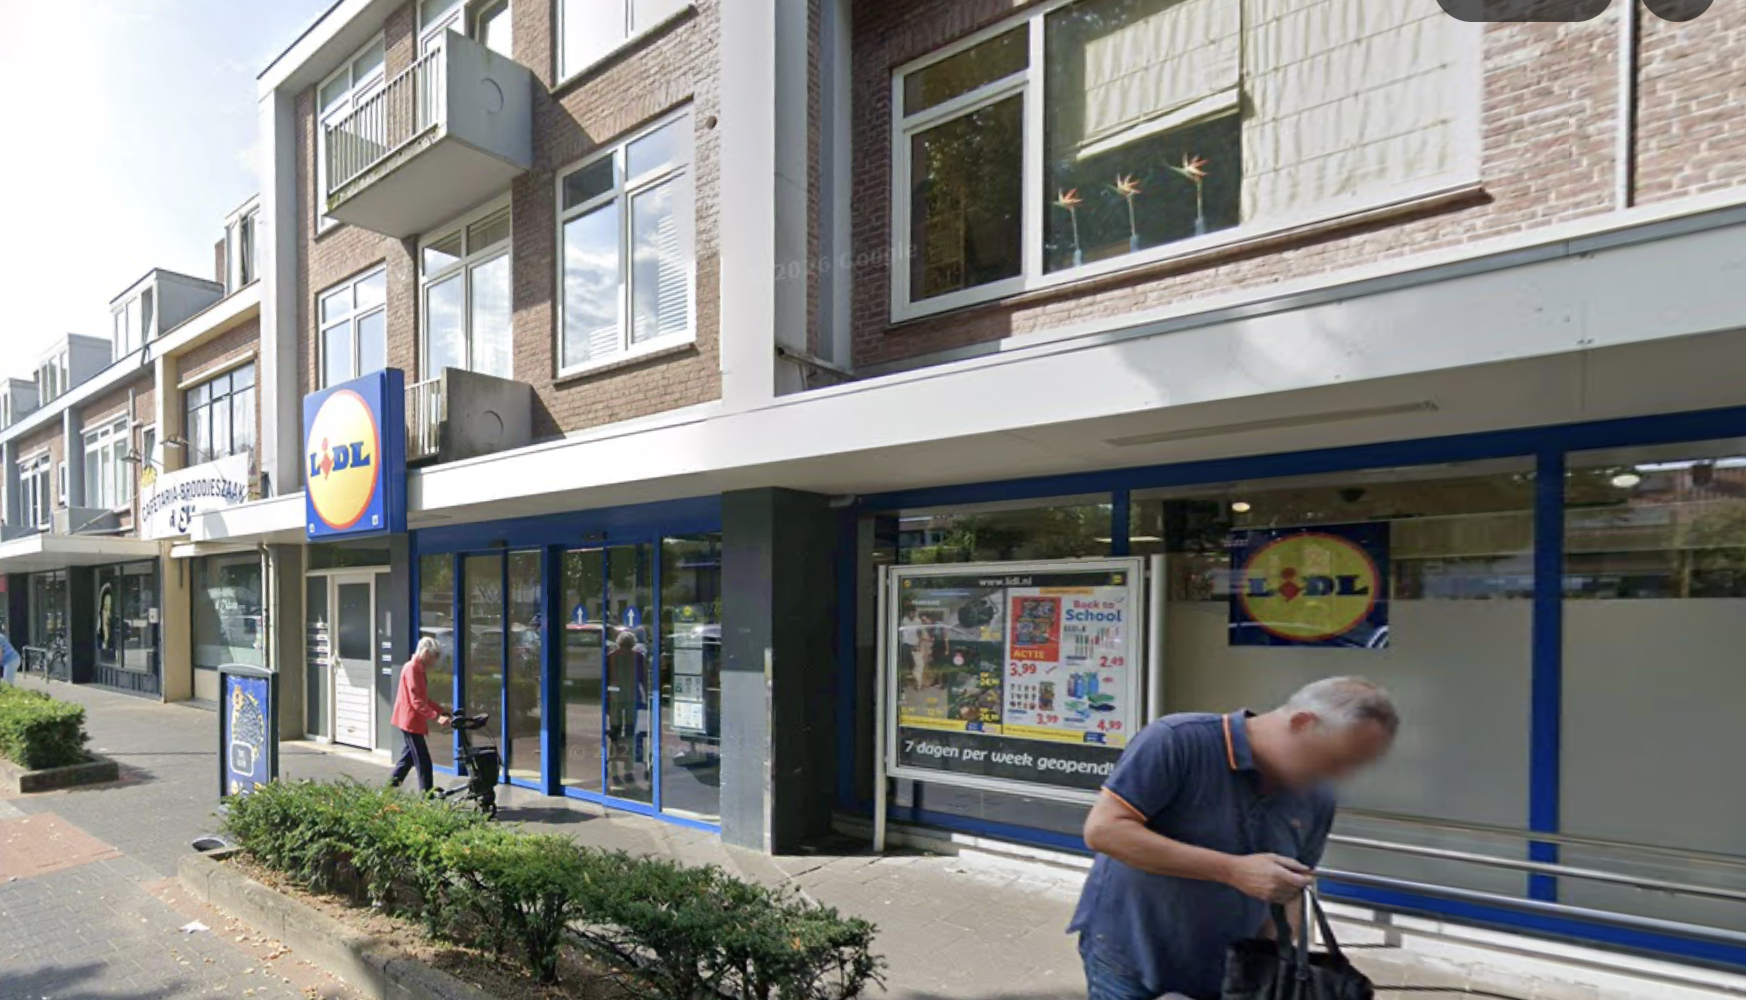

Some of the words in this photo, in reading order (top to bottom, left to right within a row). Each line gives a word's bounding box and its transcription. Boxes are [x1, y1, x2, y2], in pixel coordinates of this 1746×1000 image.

[979, 575, 1032, 587] www.lidl.nl
[1073, 600, 1099, 609] Back
[1102, 600, 1116, 609] to
[1065, 609, 1123, 622] School
[1013, 649, 1045, 659] ACTIE
[905, 740, 914, 752] 7
[917, 741, 959, 758] dagen
[962, 749, 988, 761] per
[991, 751, 1034, 767] week
